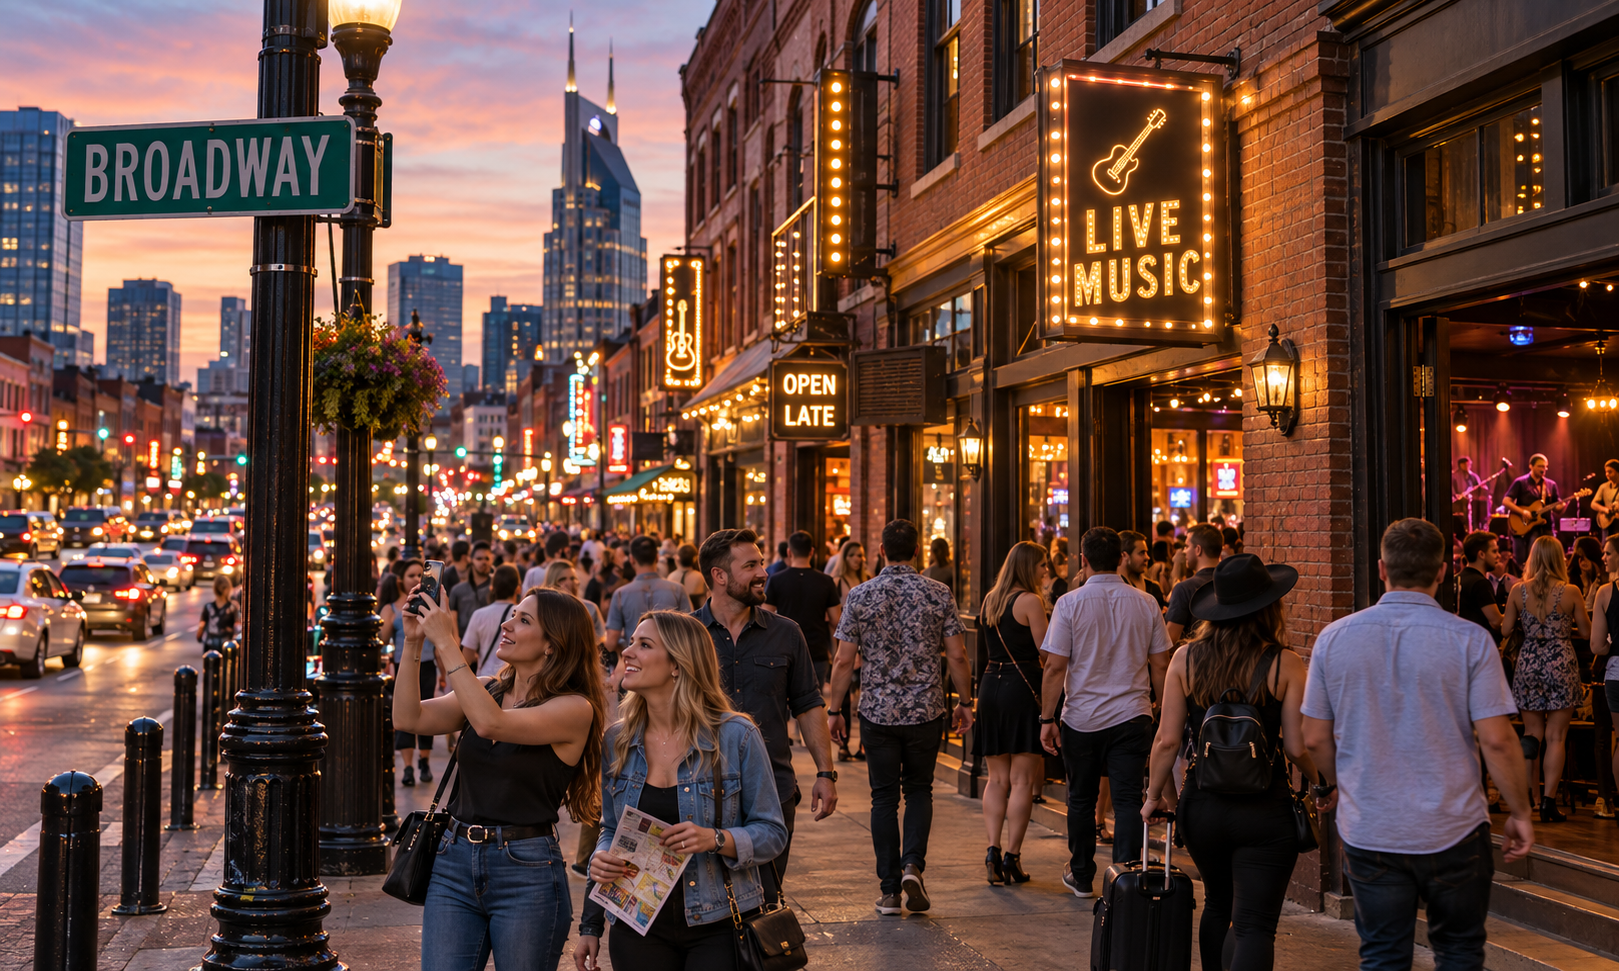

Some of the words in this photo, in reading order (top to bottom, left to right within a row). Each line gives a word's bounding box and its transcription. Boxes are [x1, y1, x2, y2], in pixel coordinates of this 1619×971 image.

[85, 135, 330, 203] BROADWAY
[1086, 199, 1181, 254] LIVE
[1074, 249, 1201, 307] MUSIC
[783, 373, 837, 395] OPEN
[784, 405, 835, 427] LATE
